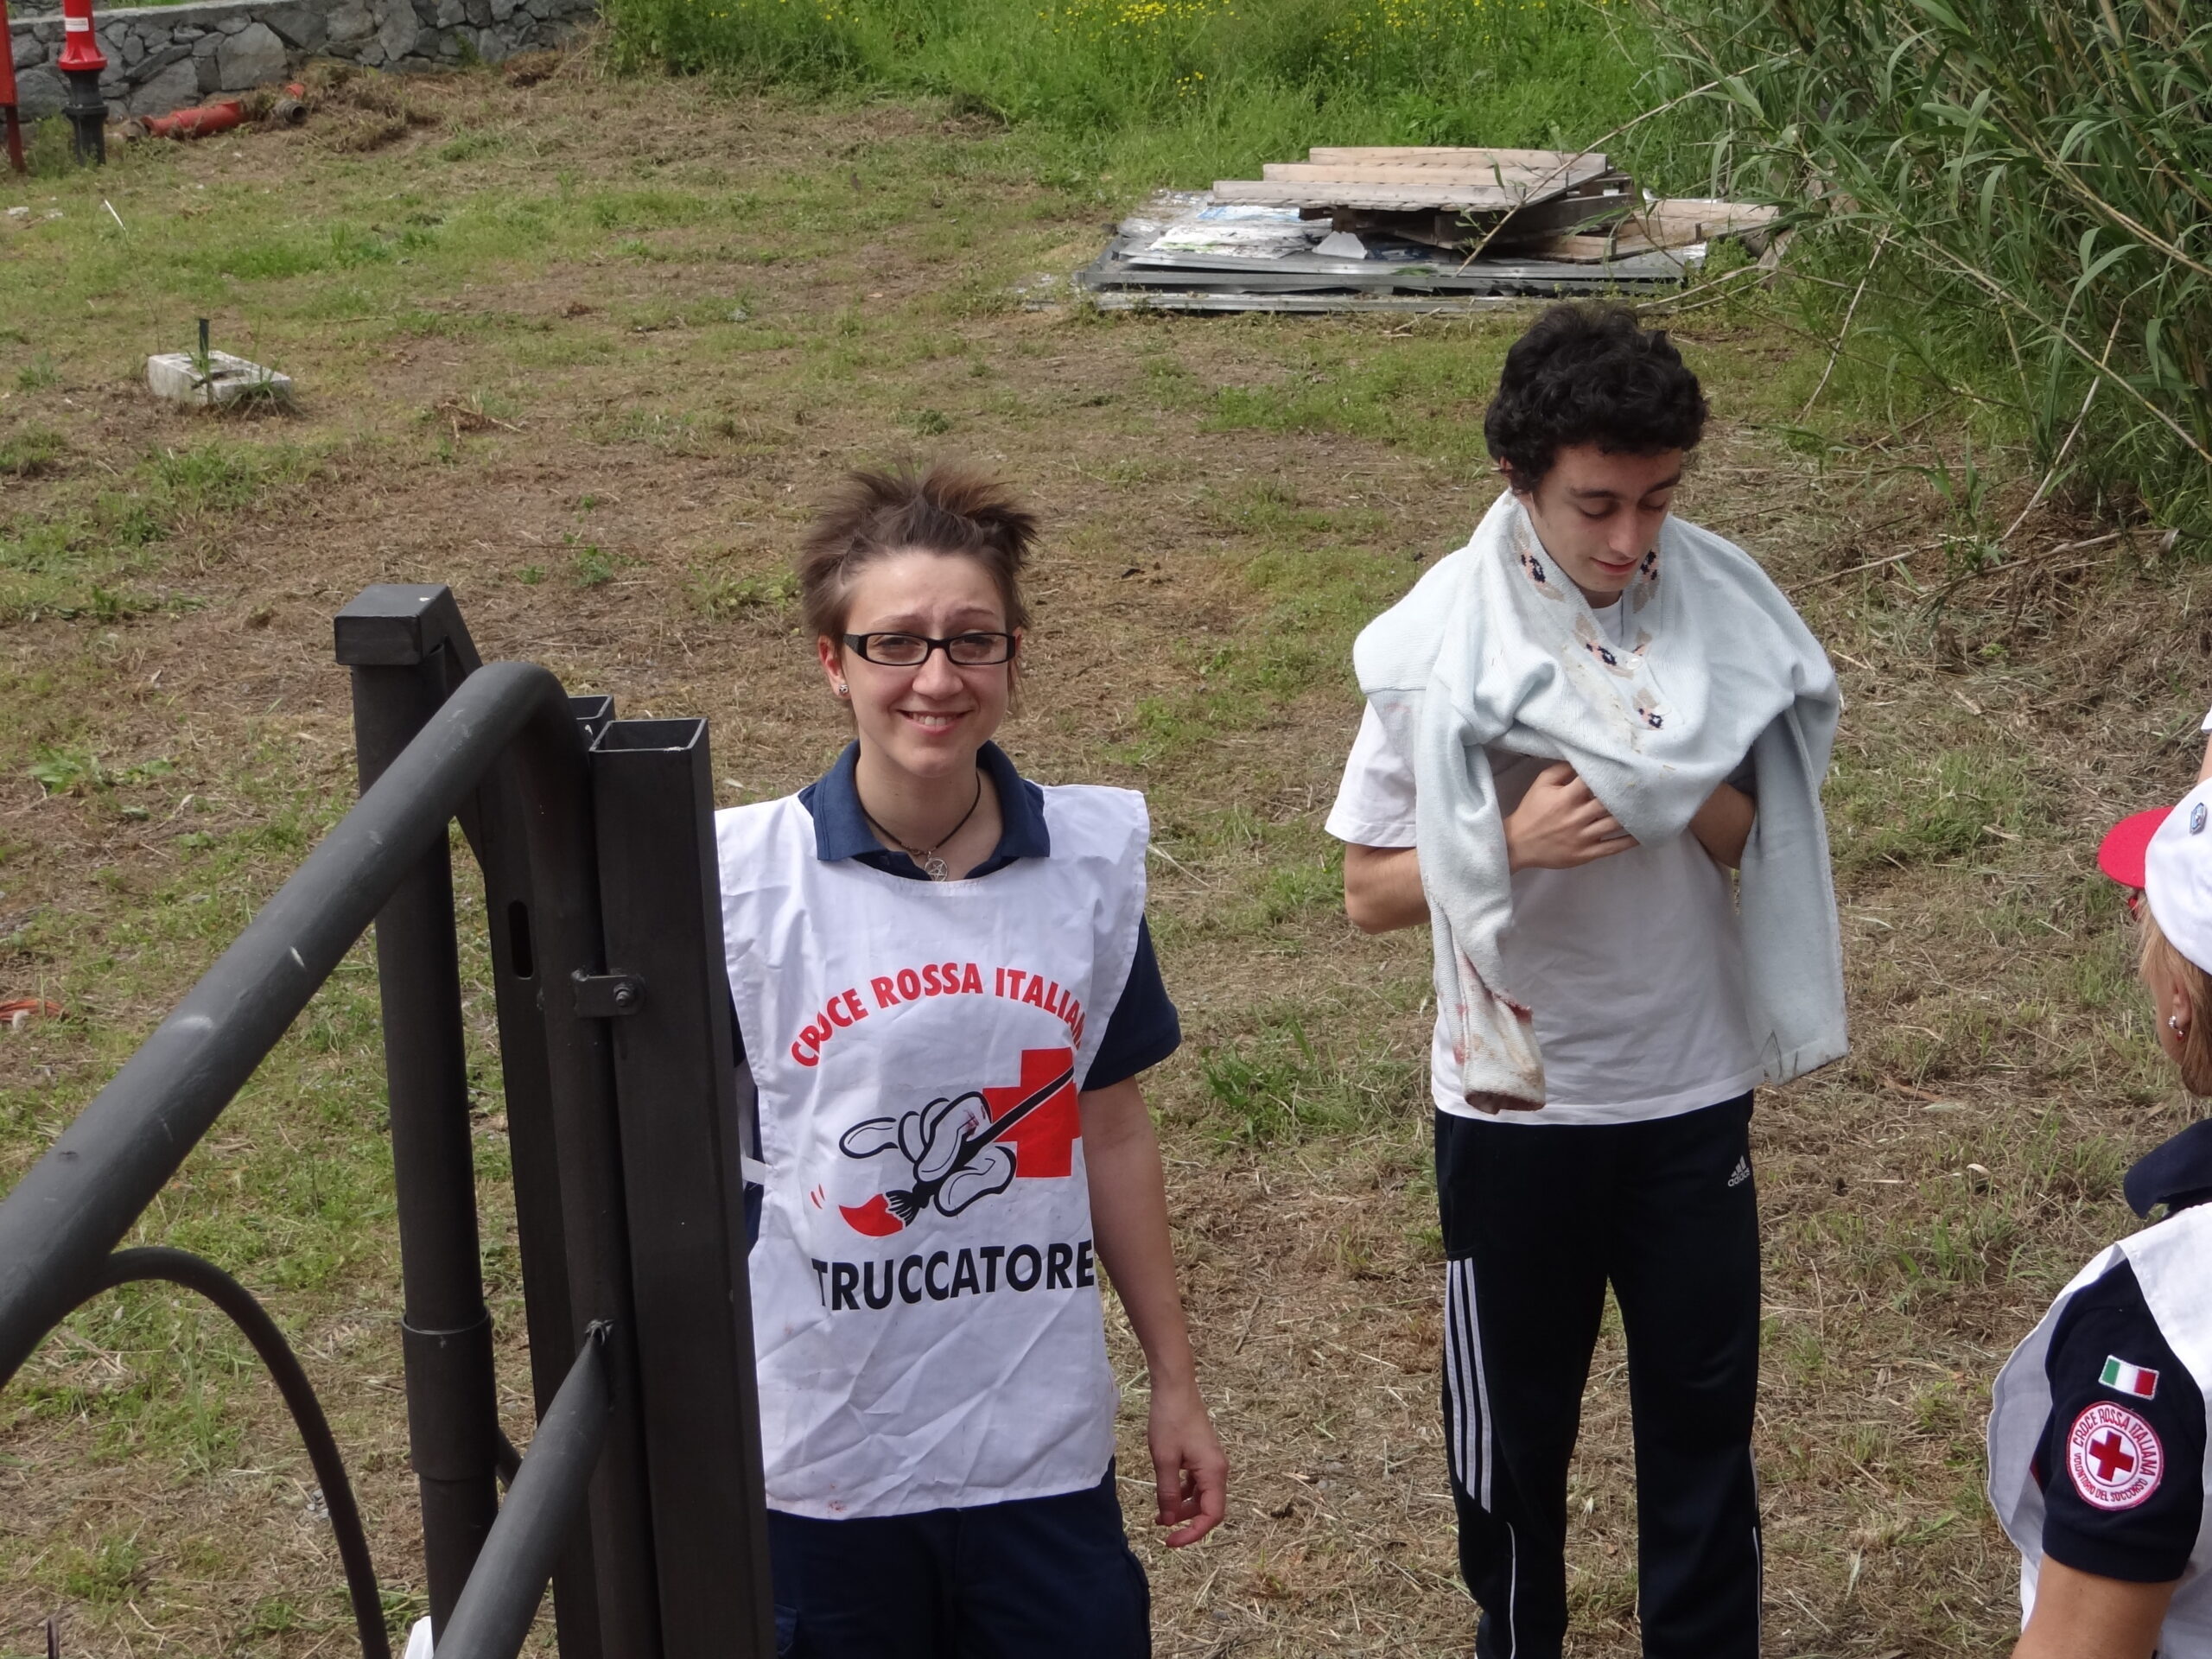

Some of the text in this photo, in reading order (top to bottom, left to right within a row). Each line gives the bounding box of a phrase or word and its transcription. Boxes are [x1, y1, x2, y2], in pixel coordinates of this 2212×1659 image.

[871, 963, 983, 1008] ROSSA
[811, 1239, 1094, 1311] TRUCCATORE
[2073, 1408, 2157, 1476] CROCE ROSSA ITALIANA
[2095, 1490, 2108, 1501] DEL
